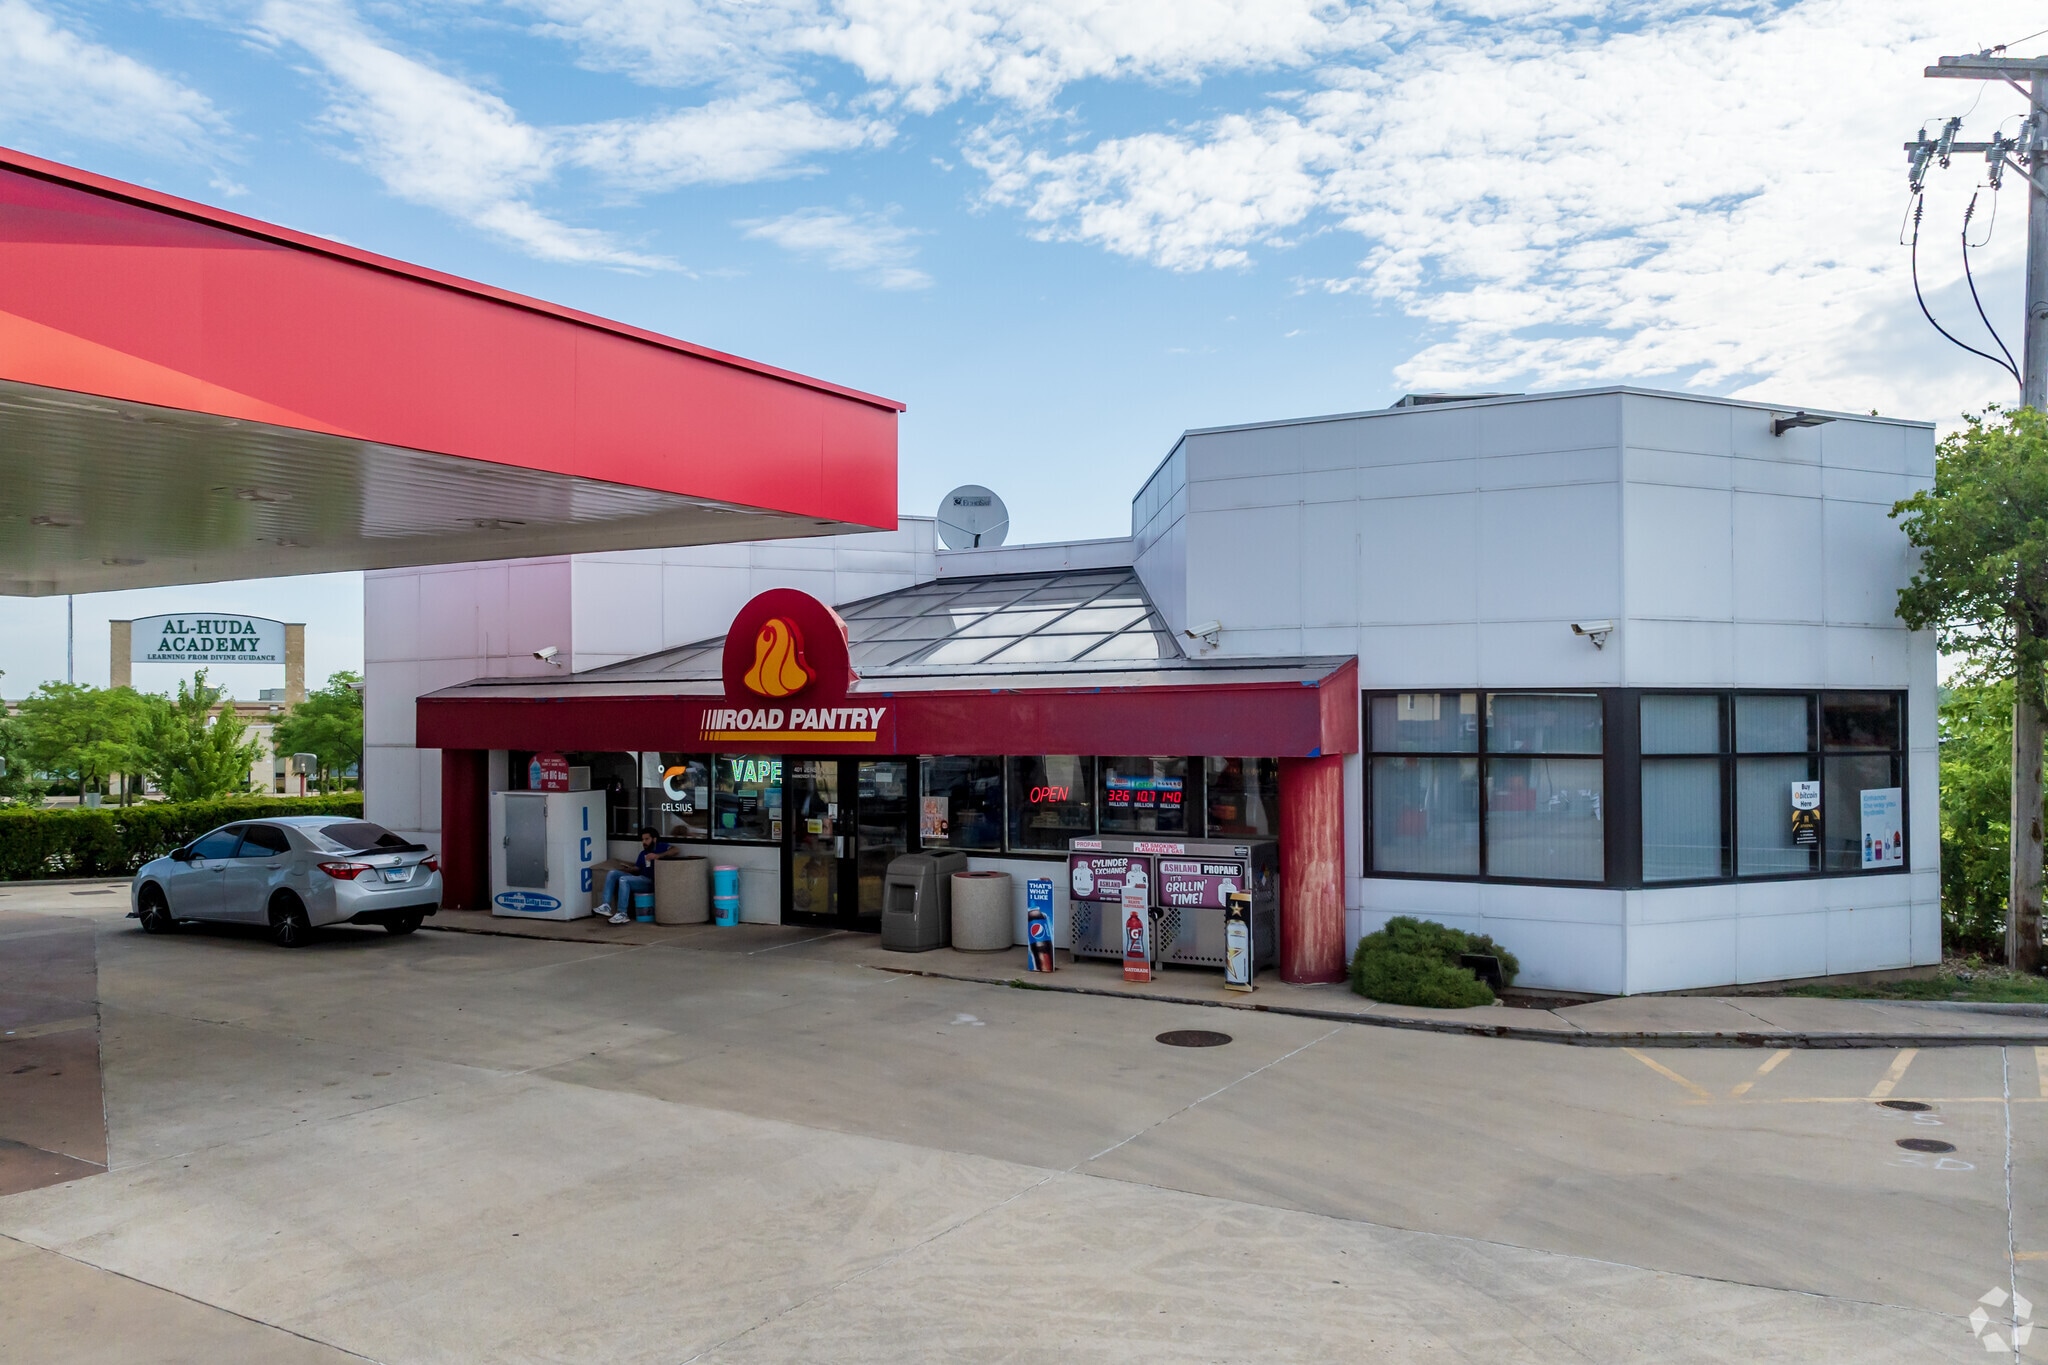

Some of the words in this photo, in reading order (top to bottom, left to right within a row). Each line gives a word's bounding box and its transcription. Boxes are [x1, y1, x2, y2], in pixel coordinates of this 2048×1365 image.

[162, 619, 257, 635] AL-HUDA
[157, 637, 261, 652] ACADEMY
[721, 708, 785, 730] ROAD
[789, 707, 887, 730] PANTRY
[731, 759, 783, 784] VAPE
[1030, 786, 1069, 803] OPEN
[1108, 789, 1130, 802] 326
[1162, 791, 1182, 803] 140
[1800, 791, 1818, 799] bitcoin
[661, 802, 693, 812] CELSIUS
[1091, 858, 1128, 868] CYLINDER
[1164, 863, 1198, 873] ASHLAND
[1203, 865, 1239, 875] PROPANE
[1095, 866, 1127, 875] EXCHANGE
[1029, 882, 1052, 890] THAT'S
[1099, 880, 1121, 888] ASHLAND
[1165, 879, 1208, 893] GRILLIN'
[1170, 892, 1203, 905] TIME!
[1130, 929, 1139, 939] G
[1124, 966, 1149, 974] GATORADE
